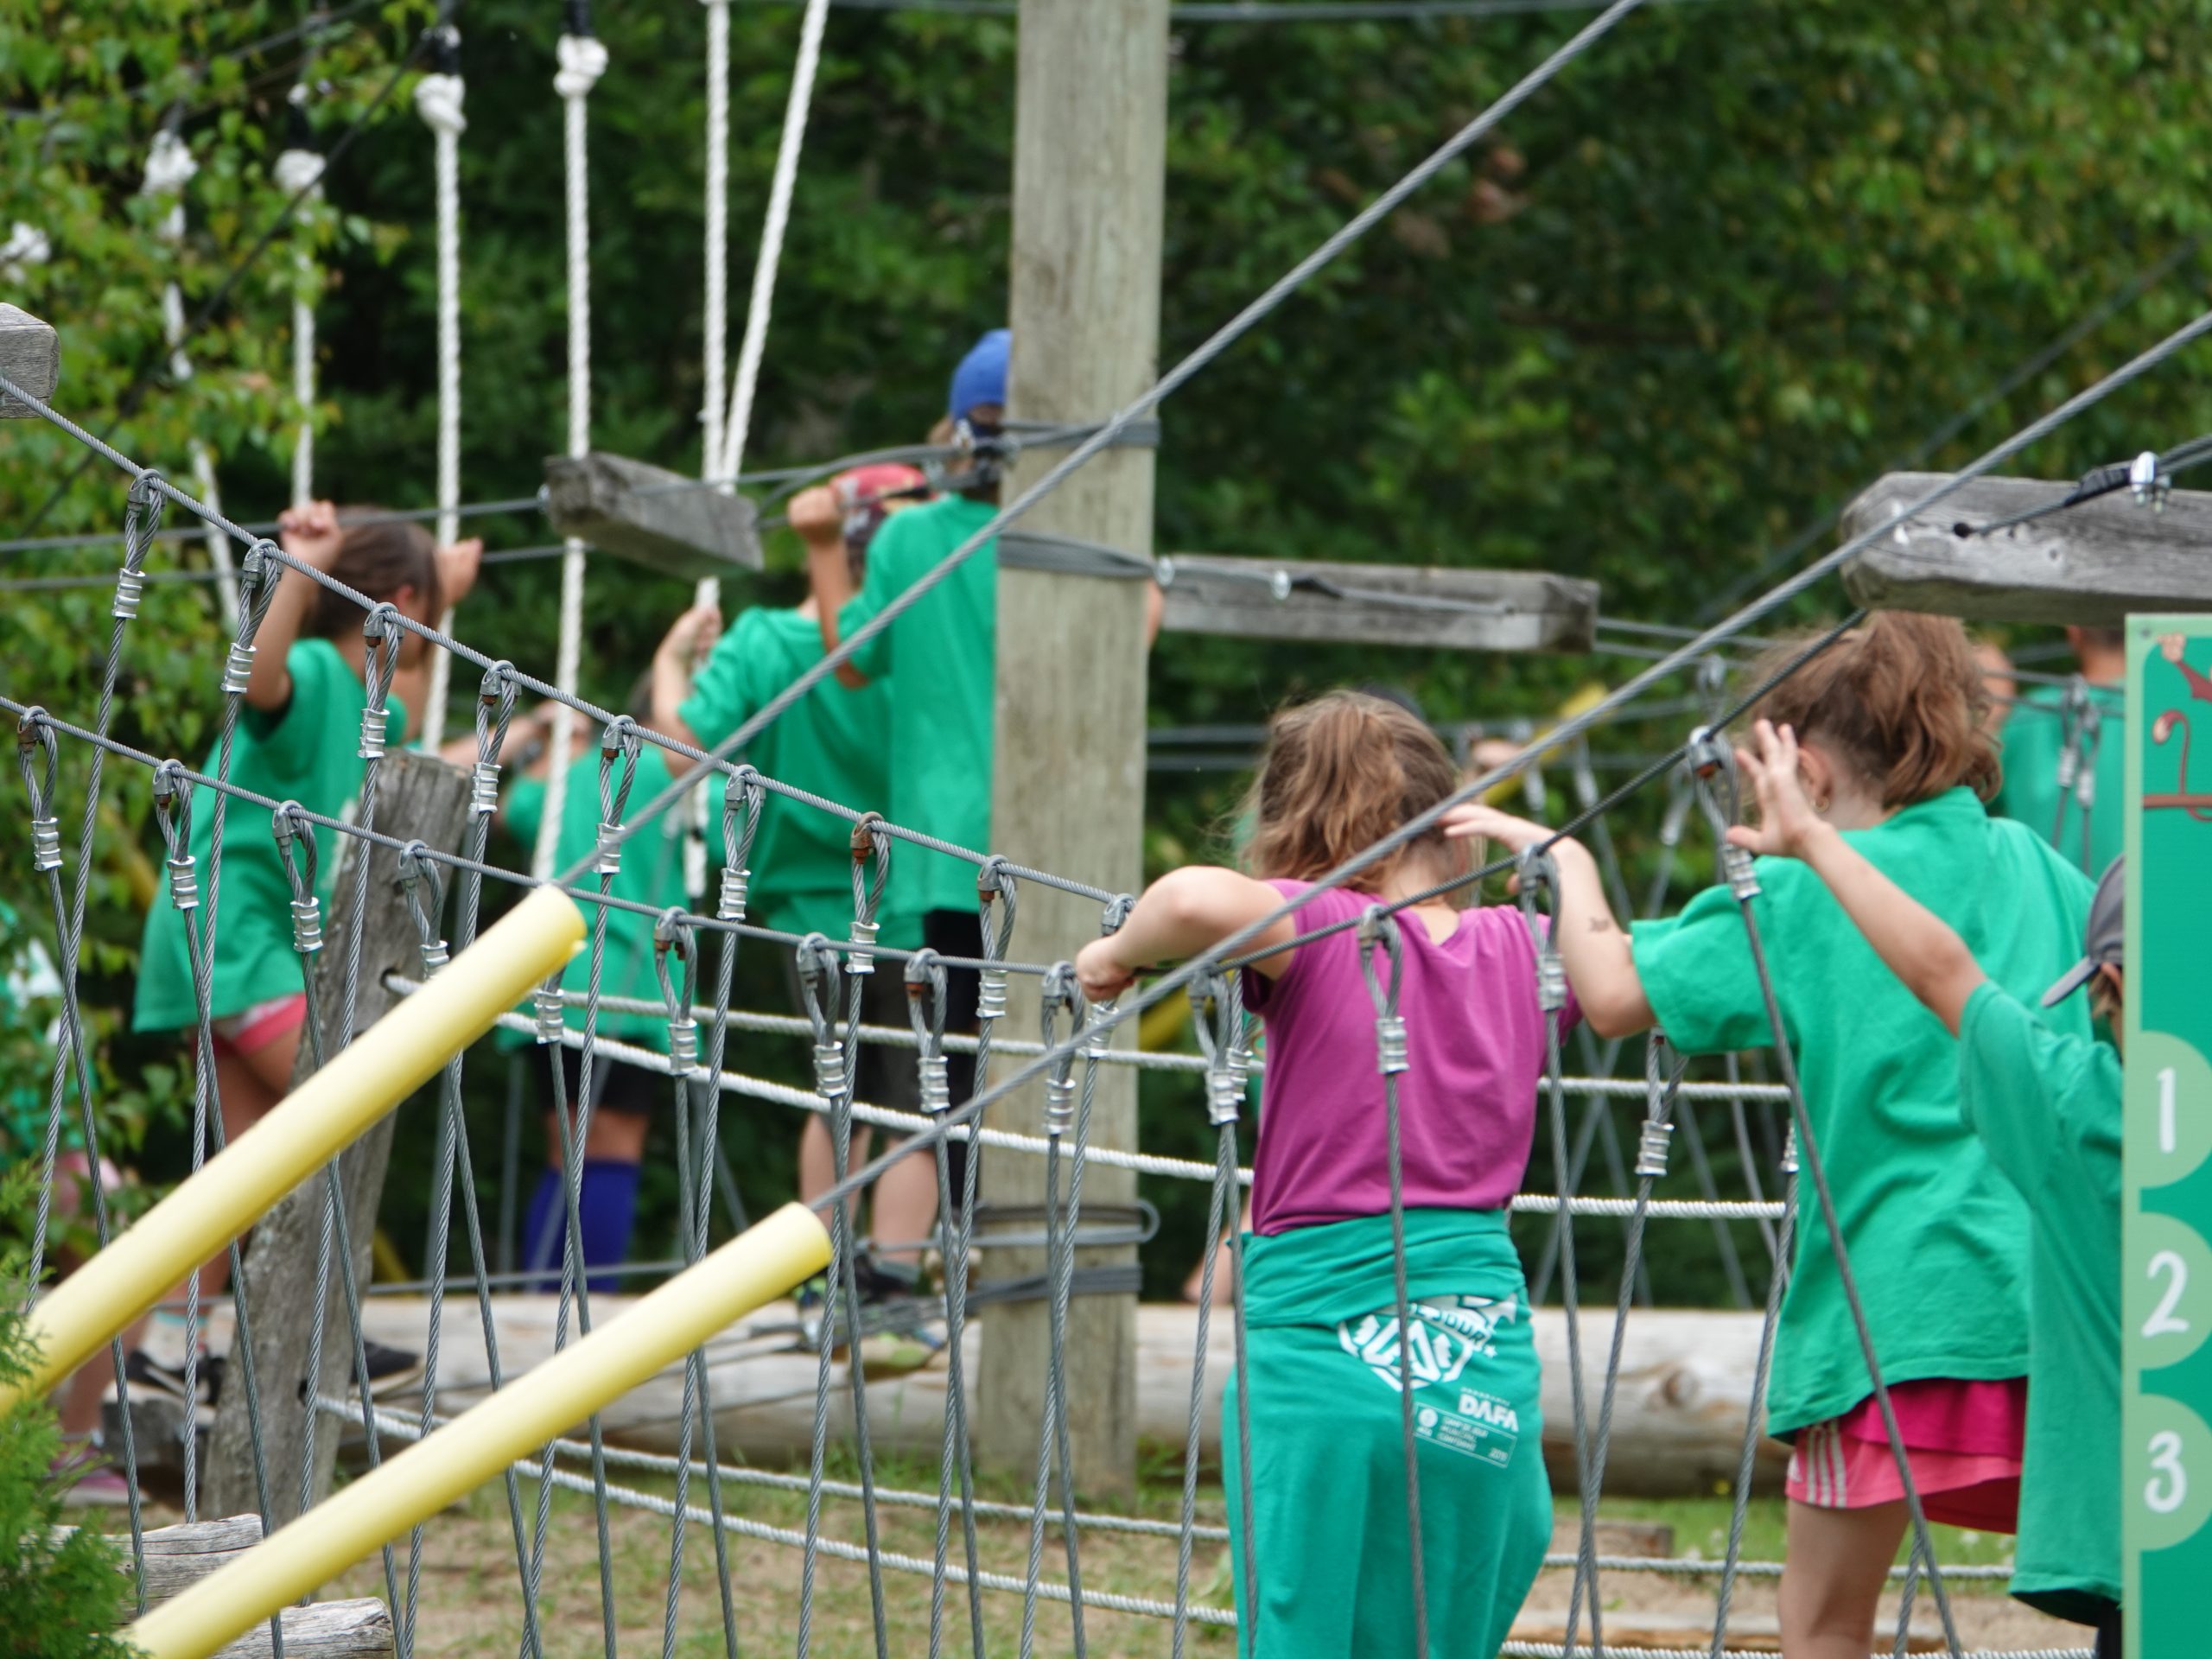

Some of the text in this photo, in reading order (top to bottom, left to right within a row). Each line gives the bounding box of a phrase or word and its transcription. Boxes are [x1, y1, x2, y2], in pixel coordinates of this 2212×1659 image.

[2157, 1066, 2176, 1153] 1
[2141, 1249, 2190, 1337] 2
[1458, 1393, 1519, 1433] DAFA
[2144, 1430, 2187, 1513] 3
